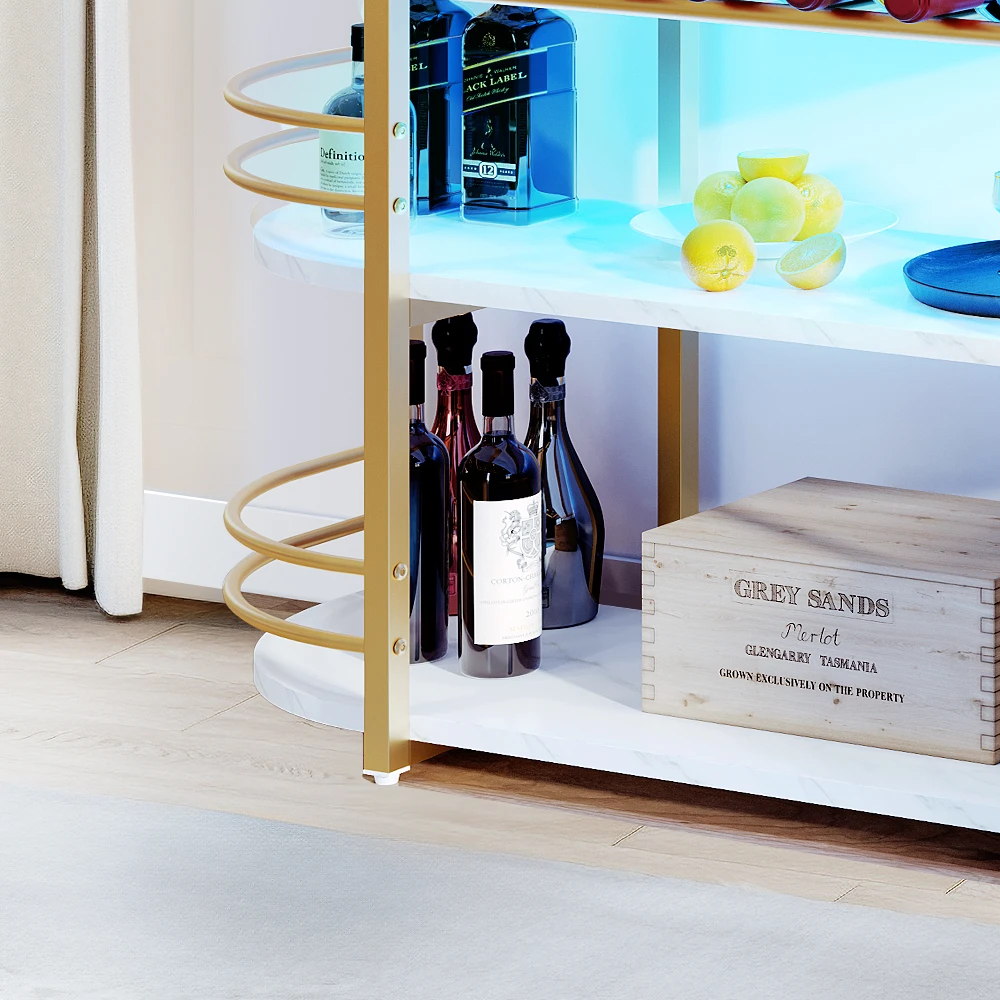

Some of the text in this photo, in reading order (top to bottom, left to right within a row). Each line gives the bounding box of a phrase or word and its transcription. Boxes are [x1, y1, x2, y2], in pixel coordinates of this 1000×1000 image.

[463, 71, 527, 94] ACK LABEL
[320, 147, 364, 161] Definitio
[482, 165, 494, 175] 12
[734, 578, 890, 618] GREY SANDS
[780, 622, 841, 646] Merlot
[744, 644, 878, 673] GLENGARRY TASMANIA
[719, 667, 905, 704] GROWN EXCLUSIVELY ON THE PROPERTY
